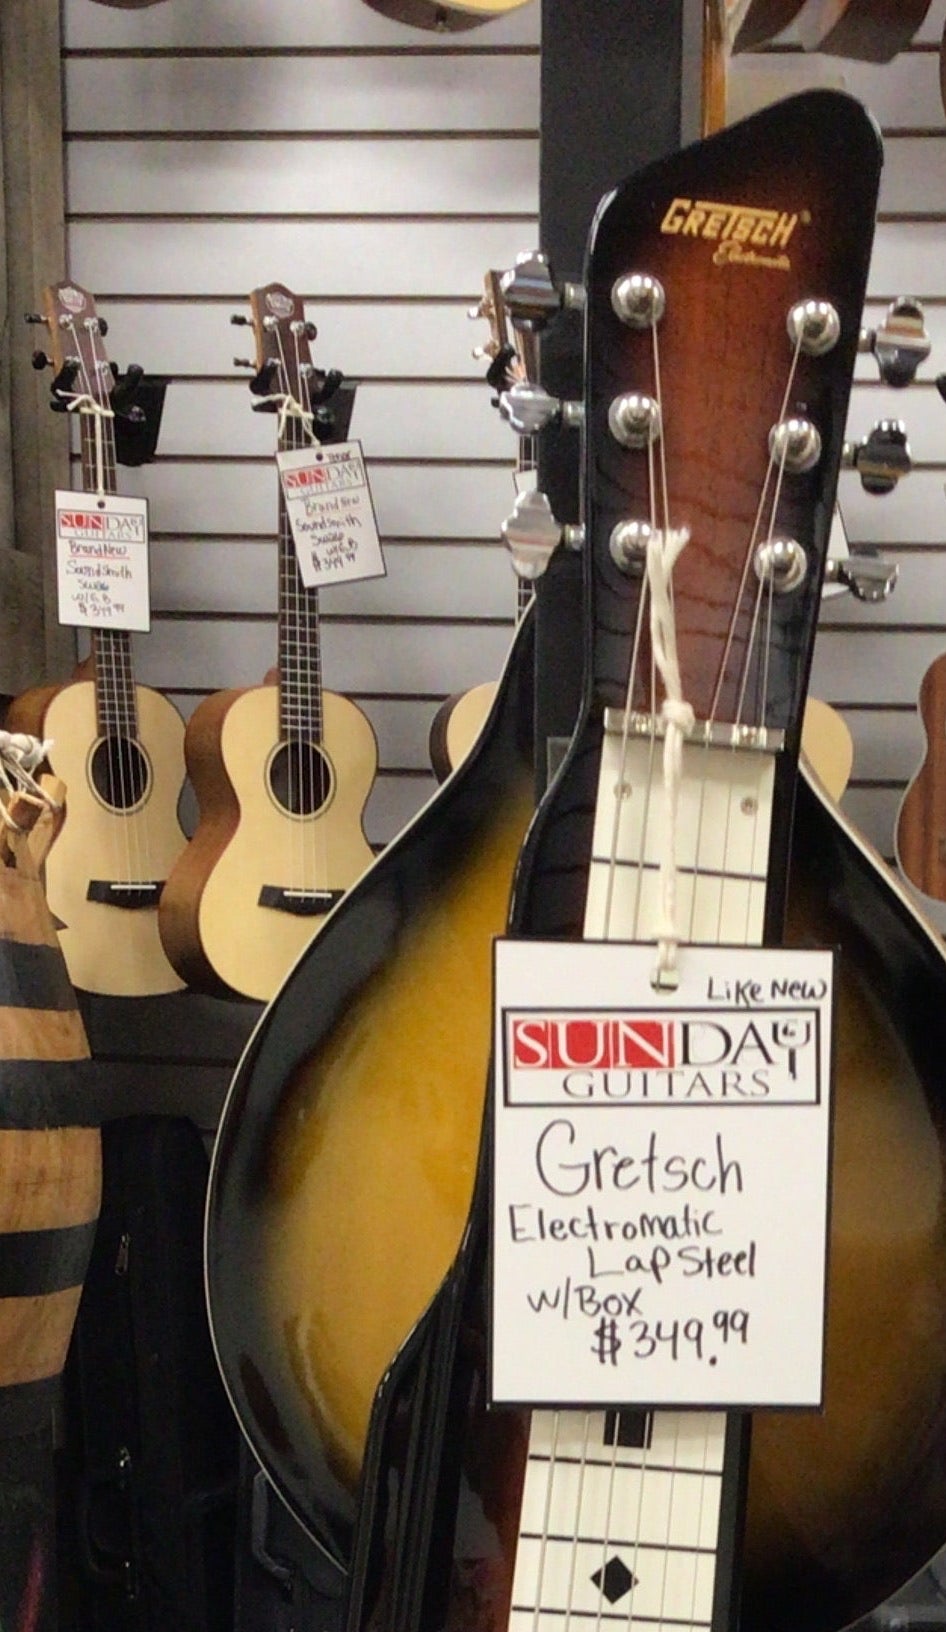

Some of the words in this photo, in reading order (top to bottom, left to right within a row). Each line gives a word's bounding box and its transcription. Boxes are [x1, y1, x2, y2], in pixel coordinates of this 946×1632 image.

[660, 198, 798, 248] GRETSCH
[284, 462, 361, 487] SUNDAY
[60, 513, 140, 536] SUNDAY
[772, 978, 827, 1001] New
[513, 1019, 812, 1081] SUNDAY
[562, 1069, 771, 1099] GUITARS
[536, 1119, 743, 1197] Gretsch
[509, 1204, 723, 1242] Electromatic
[588, 1246, 671, 1284] Lap
[682, 1241, 757, 1278] Steel
[590, 1309, 750, 1367] $349.99
